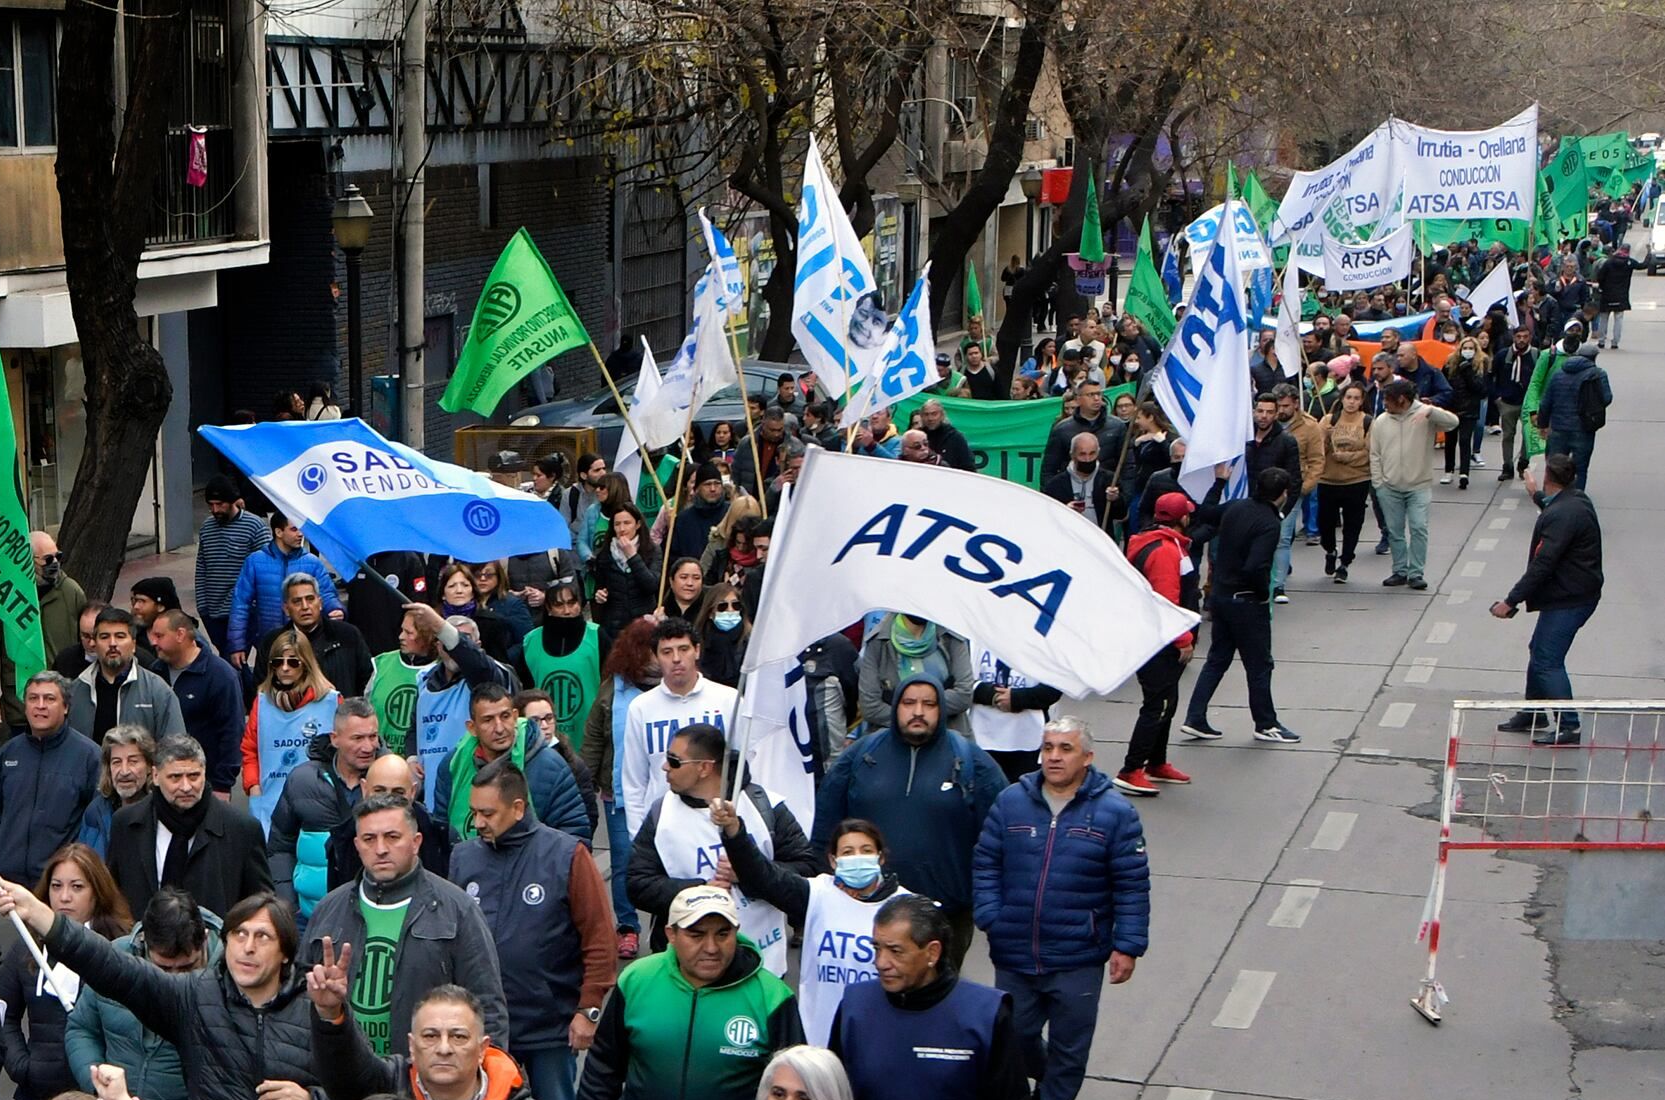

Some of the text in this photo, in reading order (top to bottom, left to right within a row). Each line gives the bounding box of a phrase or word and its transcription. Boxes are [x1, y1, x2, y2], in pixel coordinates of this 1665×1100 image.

[1408, 194, 1459, 214] ATSA
[1467, 191, 1520, 211] ATSA
[1341, 246, 1393, 269] ATSA
[831, 503, 1073, 637] ATSA
[817, 930, 874, 964] ATS
[720, 1046, 760, 1058] MENDOZA
